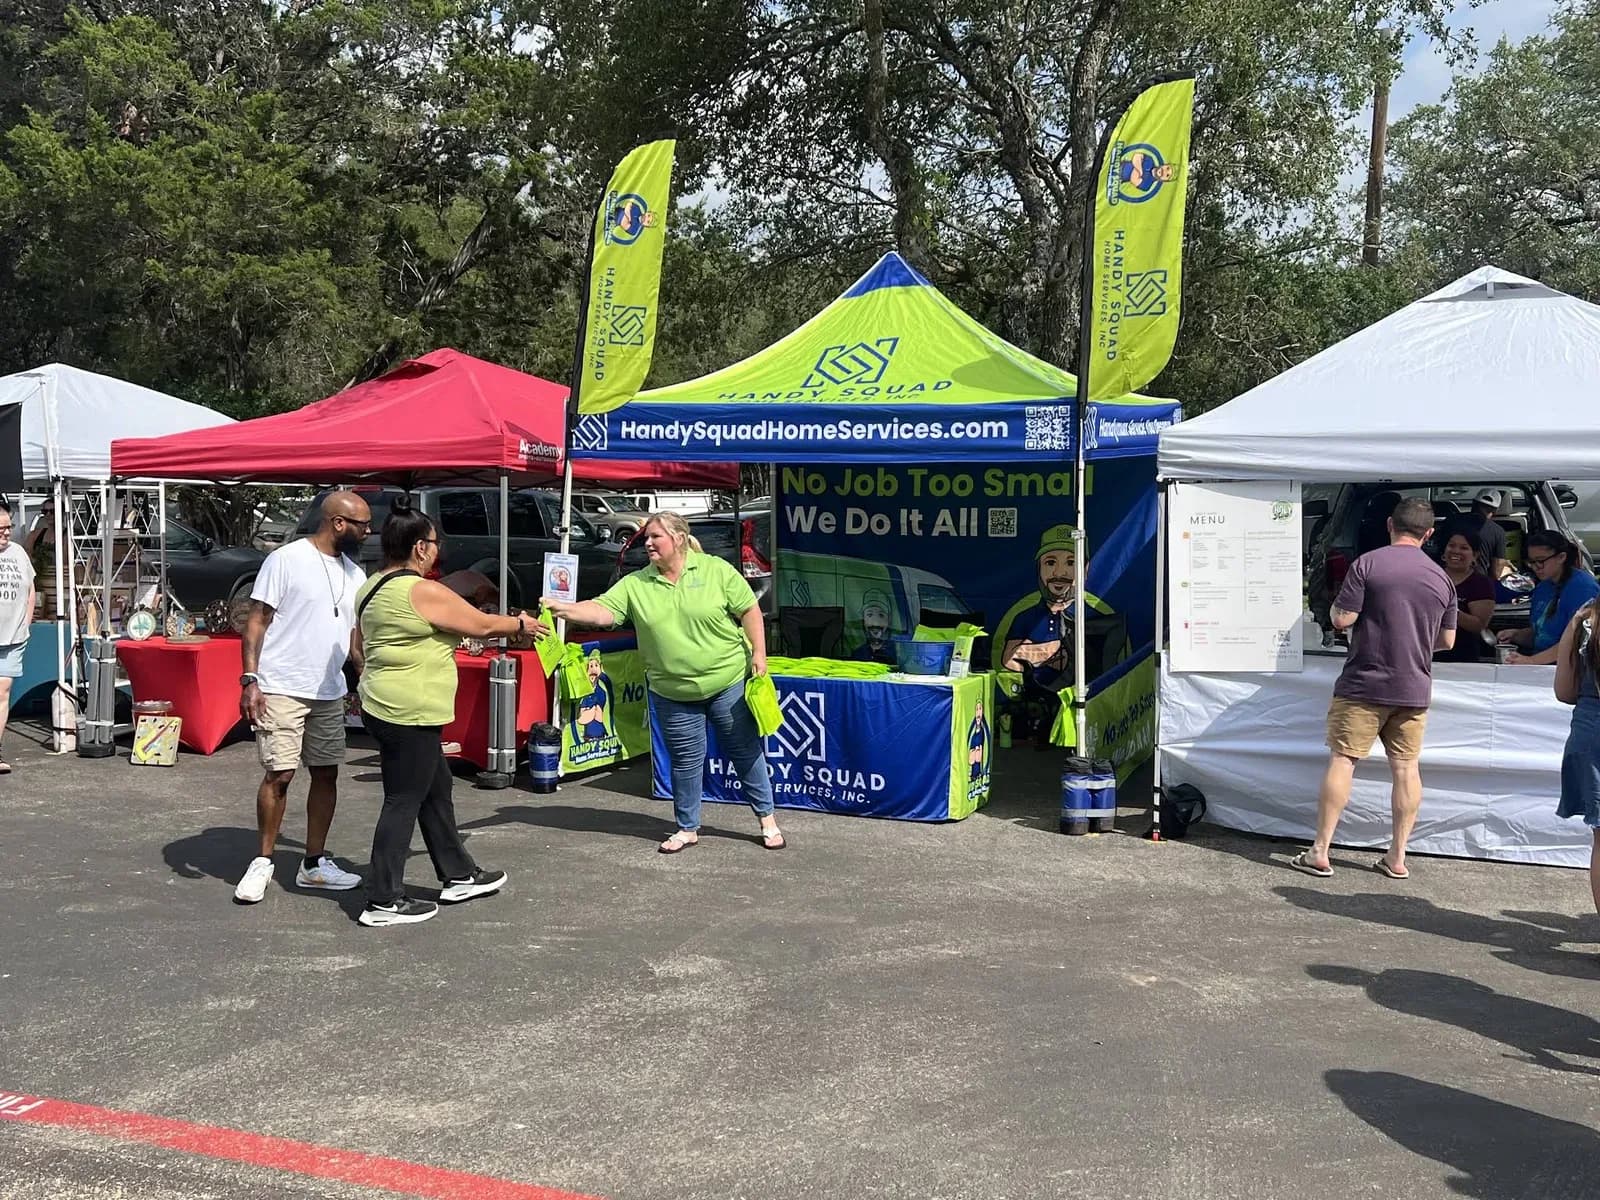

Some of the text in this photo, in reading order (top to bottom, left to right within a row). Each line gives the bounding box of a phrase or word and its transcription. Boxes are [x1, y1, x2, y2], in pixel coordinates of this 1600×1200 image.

[1103, 240, 1112, 270] HOME
[596, 275, 605, 300] HOME
[1106, 230, 1125, 361] HANDY SQUAD
[595, 267, 616, 380] HANDY SQUAD
[718, 381, 953, 399] HANDY SQUAD
[621, 417, 1008, 446] HandySquadHomeServices.com
[520, 438, 564, 460] Academy
[782, 465, 1094, 497] No Job Too Smal
[785, 505, 978, 537] We Do It All
[1190, 515, 1225, 525] MENU
[571, 741, 597, 758] HANDY
[709, 758, 886, 791] HADY SQUAD
[725, 779, 871, 804] HO ERVICES, INC.
